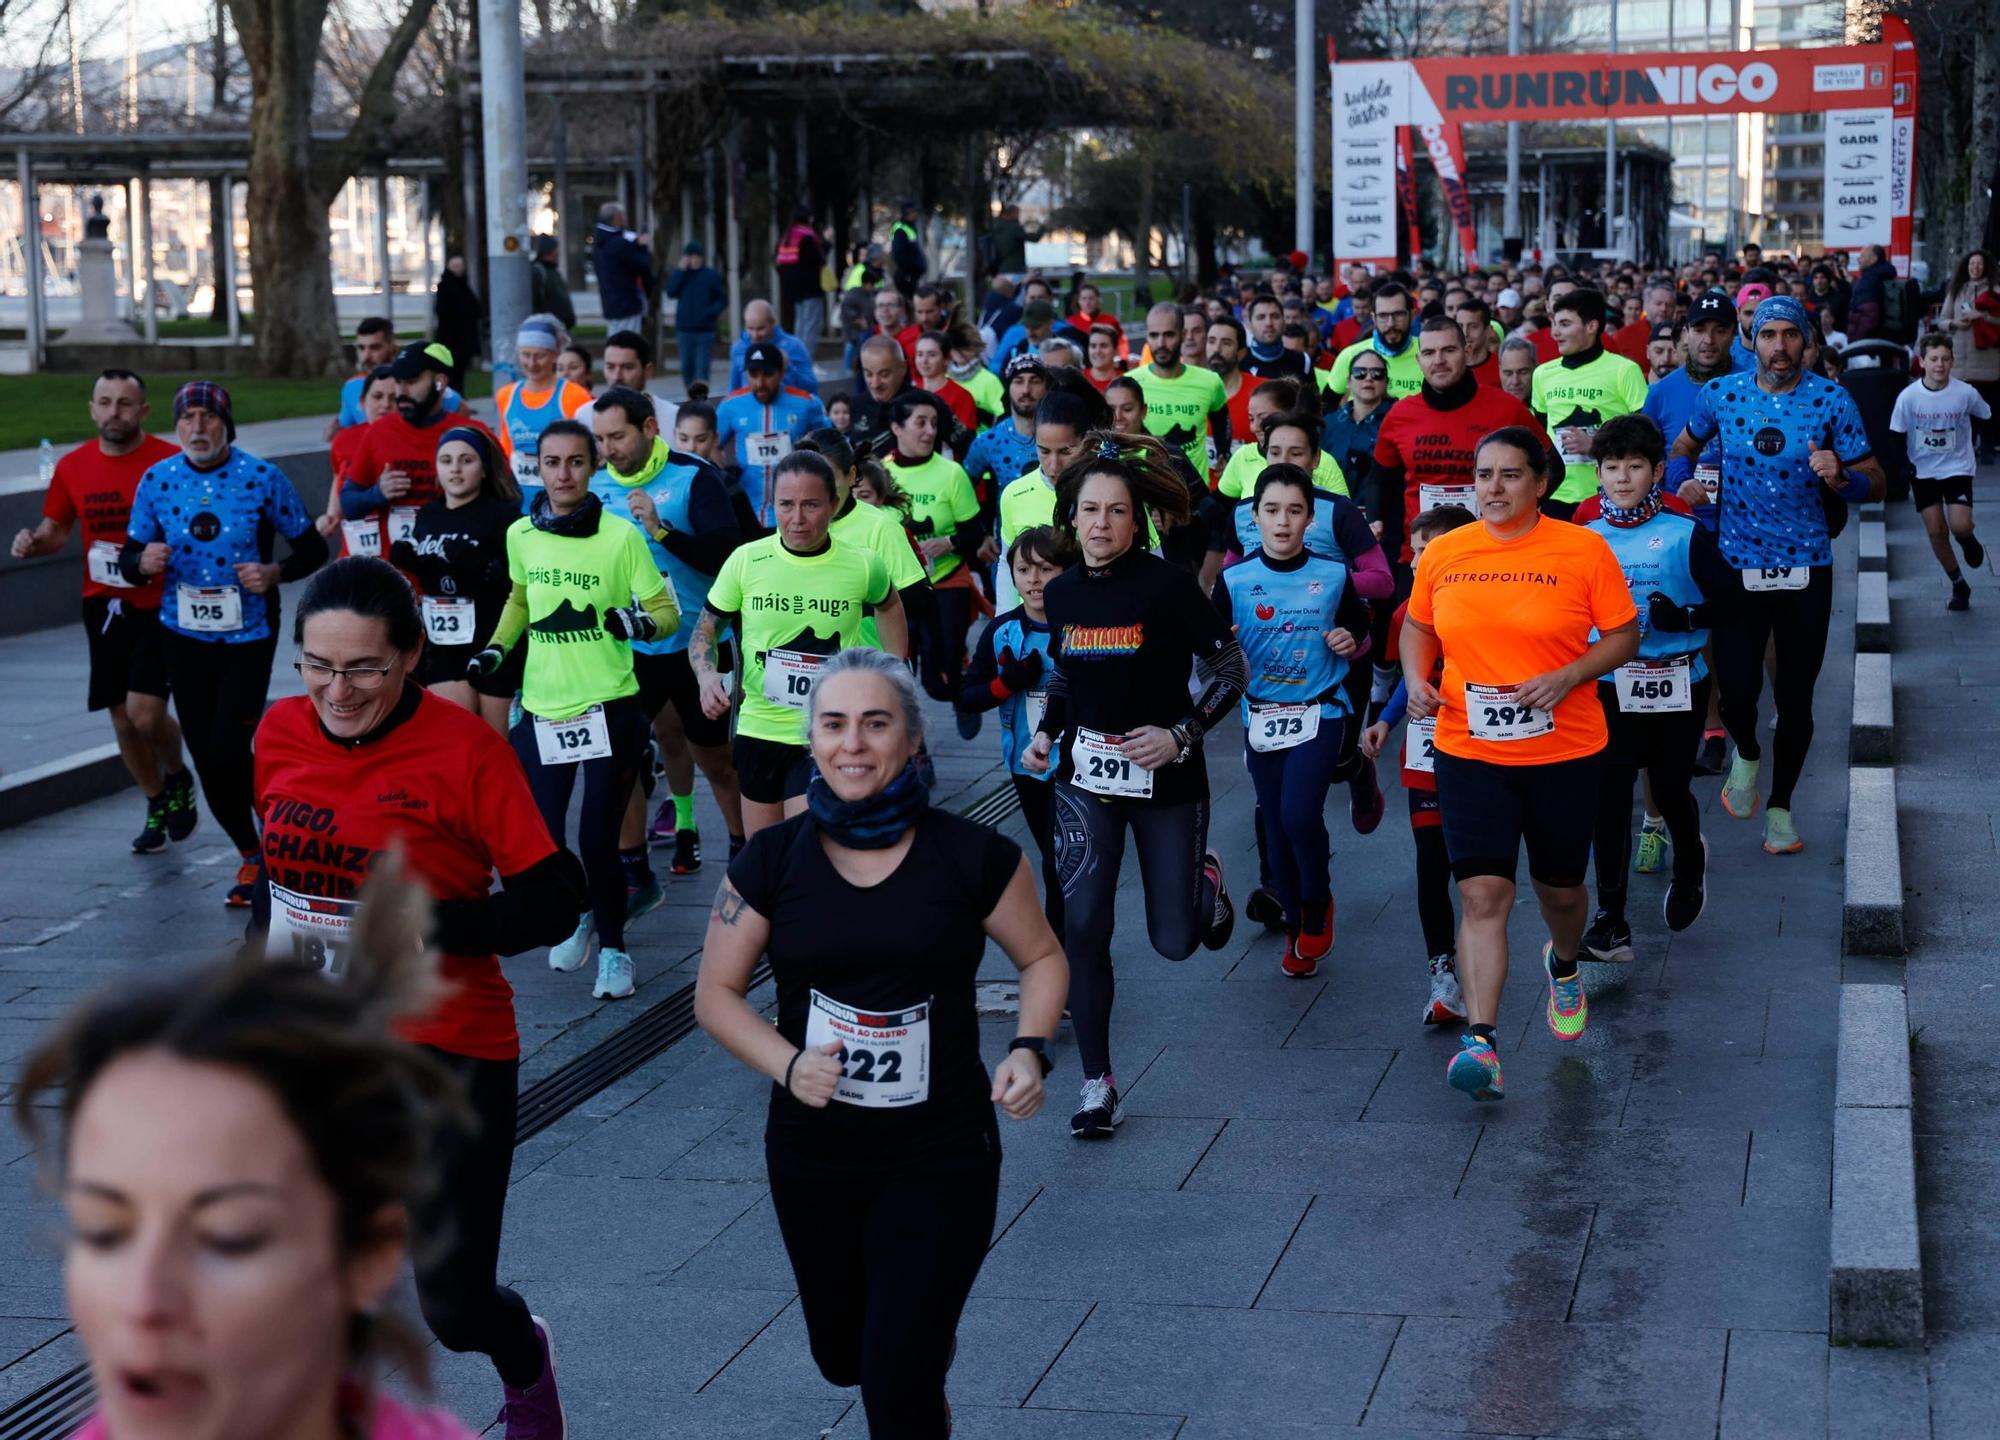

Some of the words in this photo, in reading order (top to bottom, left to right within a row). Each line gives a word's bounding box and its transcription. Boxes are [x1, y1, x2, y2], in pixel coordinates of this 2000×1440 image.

[1840, 135, 1879, 145] GADIS
[1346, 157, 1382, 166] GADIS
[1838, 196, 1878, 206] GADIS
[1346, 215, 1382, 225] GADIS
[1576, 388, 1603, 400] auga
[1175, 404, 1200, 416] auga
[758, 445, 779, 457] 176
[1642, 561, 1660, 569] Duval
[564, 571, 600, 590] auga
[1445, 572, 1557, 586] METROPOLITAN
[752, 592, 790, 612] máis
[808, 599, 849, 617] auga
[1278, 607, 1302, 615] Saunier
[1303, 607, 1321, 615] Duval
[191, 605, 223, 620] 125
[788, 675, 811, 696] 10
[1631, 680, 1673, 699] 450
[1483, 705, 1534, 726] 292
[1264, 717, 1303, 738] 373
[556, 727, 592, 750] 132
[1086, 741, 1104, 749] SUBIDA
[1089, 756, 1130, 780] 291
[270, 799, 340, 836] VIGO,
[1068, 831, 1085, 842] 15
[286, 907, 309, 923] SUBIDA
[311, 915, 323, 925] AO
[828, 1017, 855, 1035] SUBIDA
[857, 1027, 870, 1038] AO
[872, 1028, 909, 1040] CASTRO
[839, 1089, 865, 1100] GADIS
